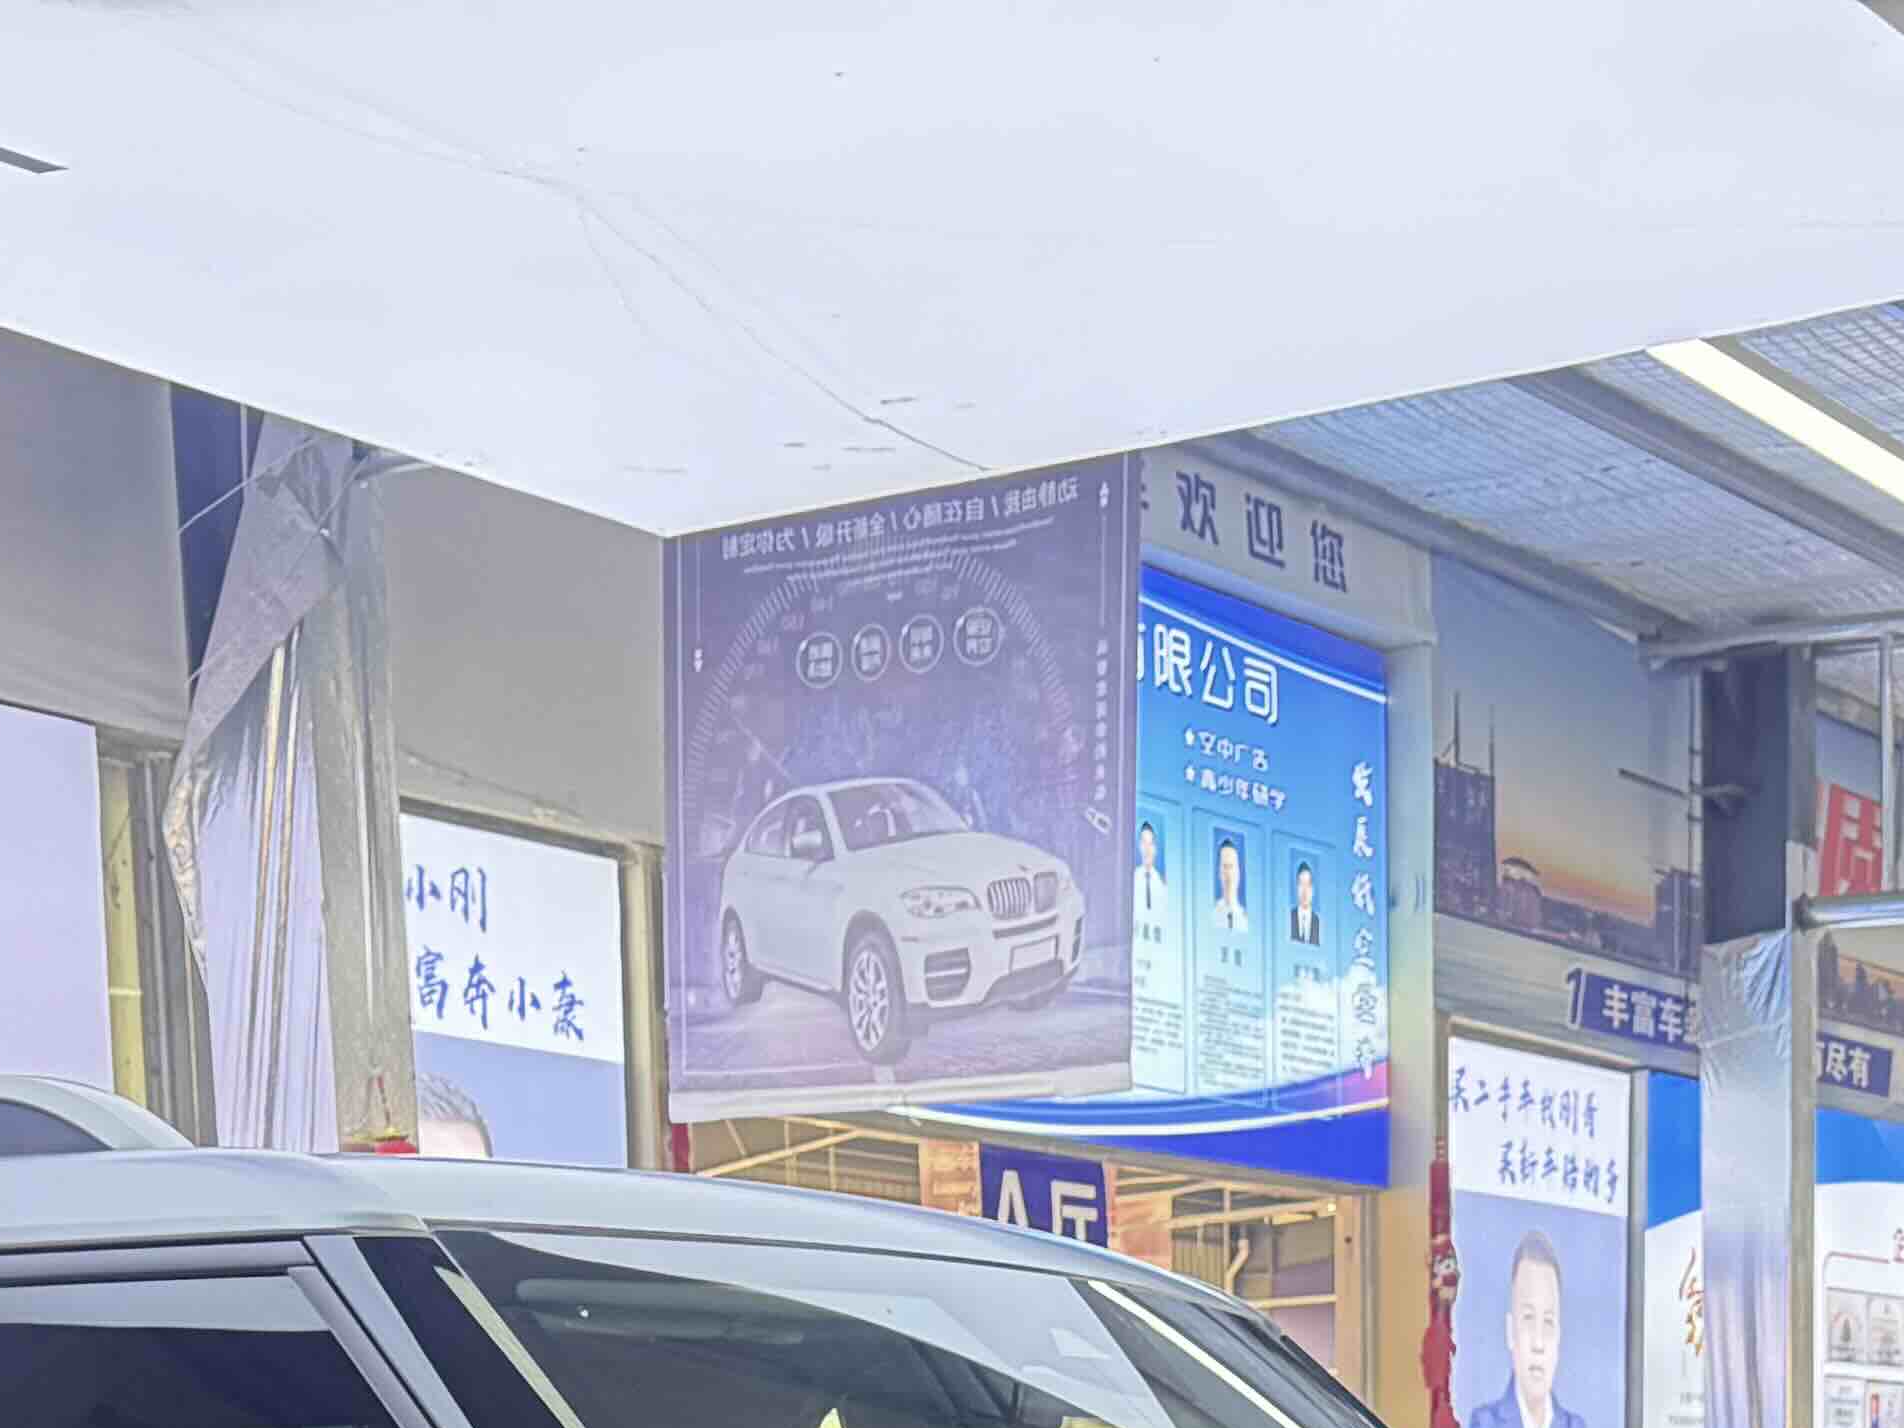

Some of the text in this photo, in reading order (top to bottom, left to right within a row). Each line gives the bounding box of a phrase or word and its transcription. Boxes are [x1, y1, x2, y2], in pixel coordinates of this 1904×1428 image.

[1175, 470, 1349, 594] 欢迎您
[1137, 622, 1280, 727] 限公司
[405, 863, 487, 935] 小刚
